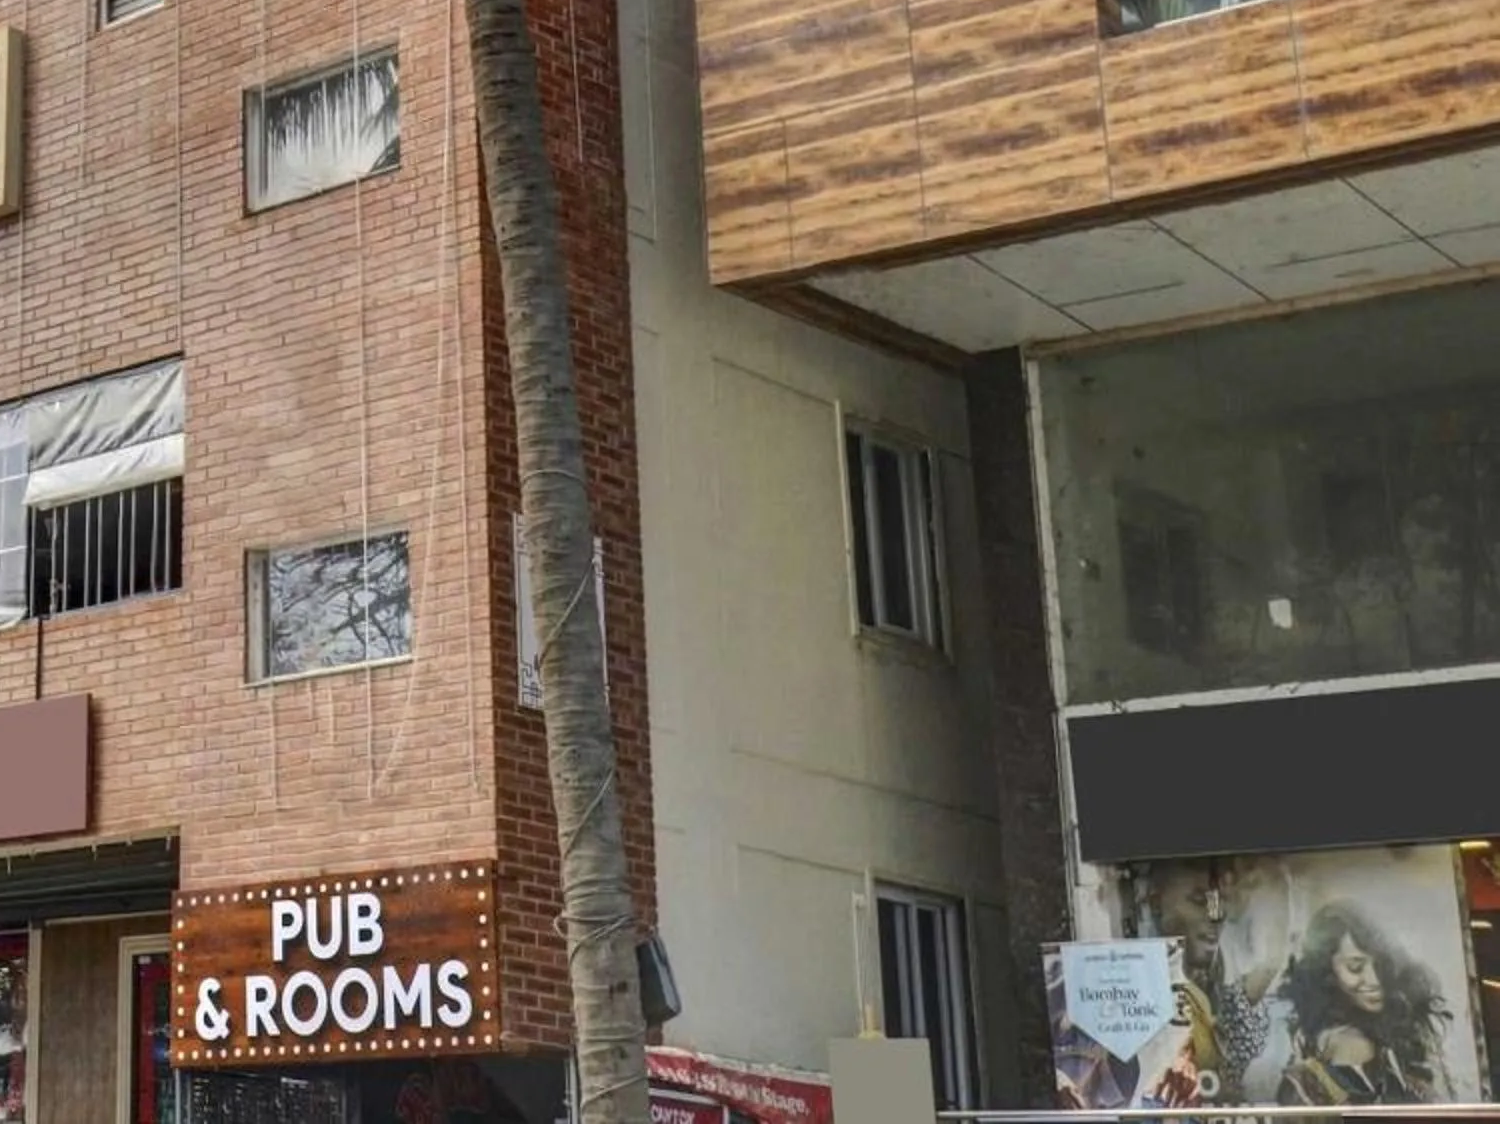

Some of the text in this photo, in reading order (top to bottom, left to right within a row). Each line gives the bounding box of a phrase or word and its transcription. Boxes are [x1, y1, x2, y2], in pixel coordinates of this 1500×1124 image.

[271, 892, 384, 962] PUB
[195, 959, 473, 1041] & ROOMS
